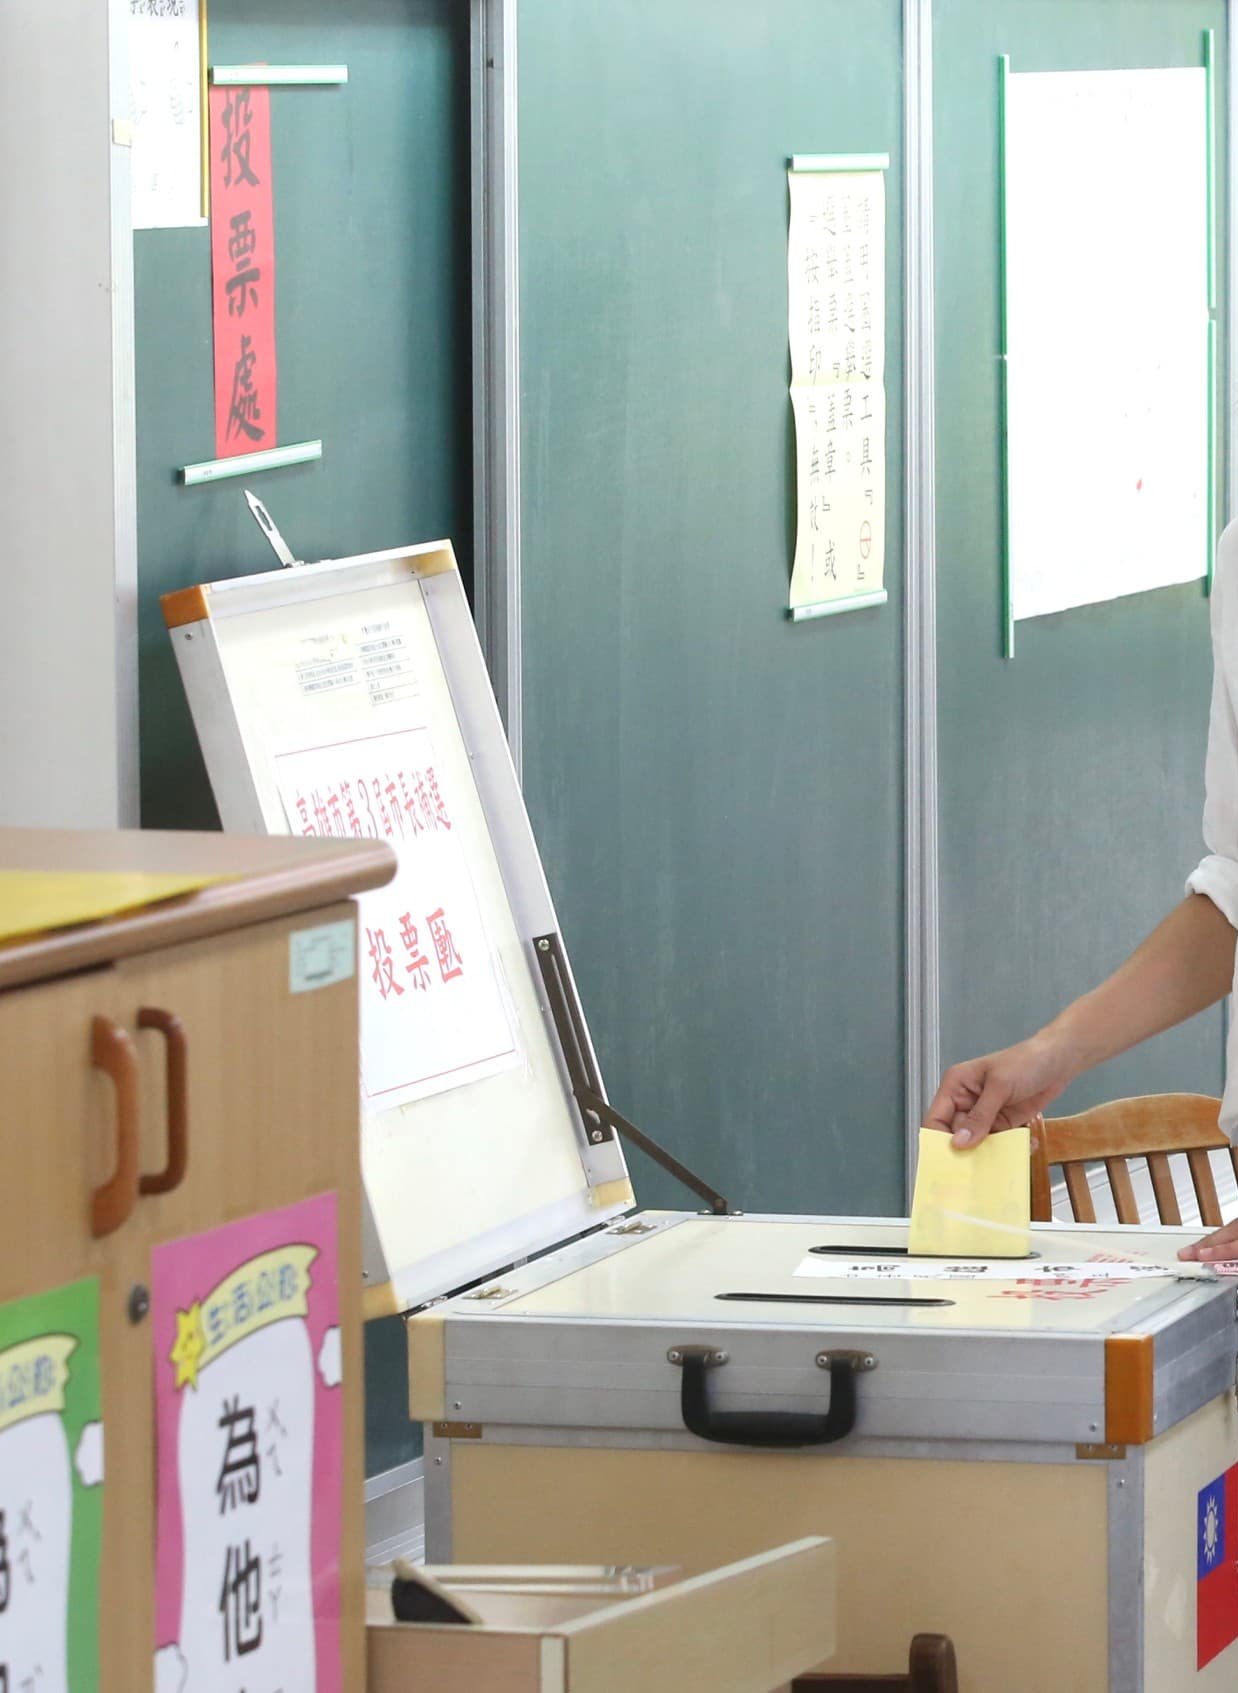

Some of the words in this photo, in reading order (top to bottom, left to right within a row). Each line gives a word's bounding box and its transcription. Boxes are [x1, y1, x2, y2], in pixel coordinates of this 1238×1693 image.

[221, 87, 265, 443] 投票處
[365, 906, 463, 1001] 投票匭
[216, 1394, 263, 1693] 為他
